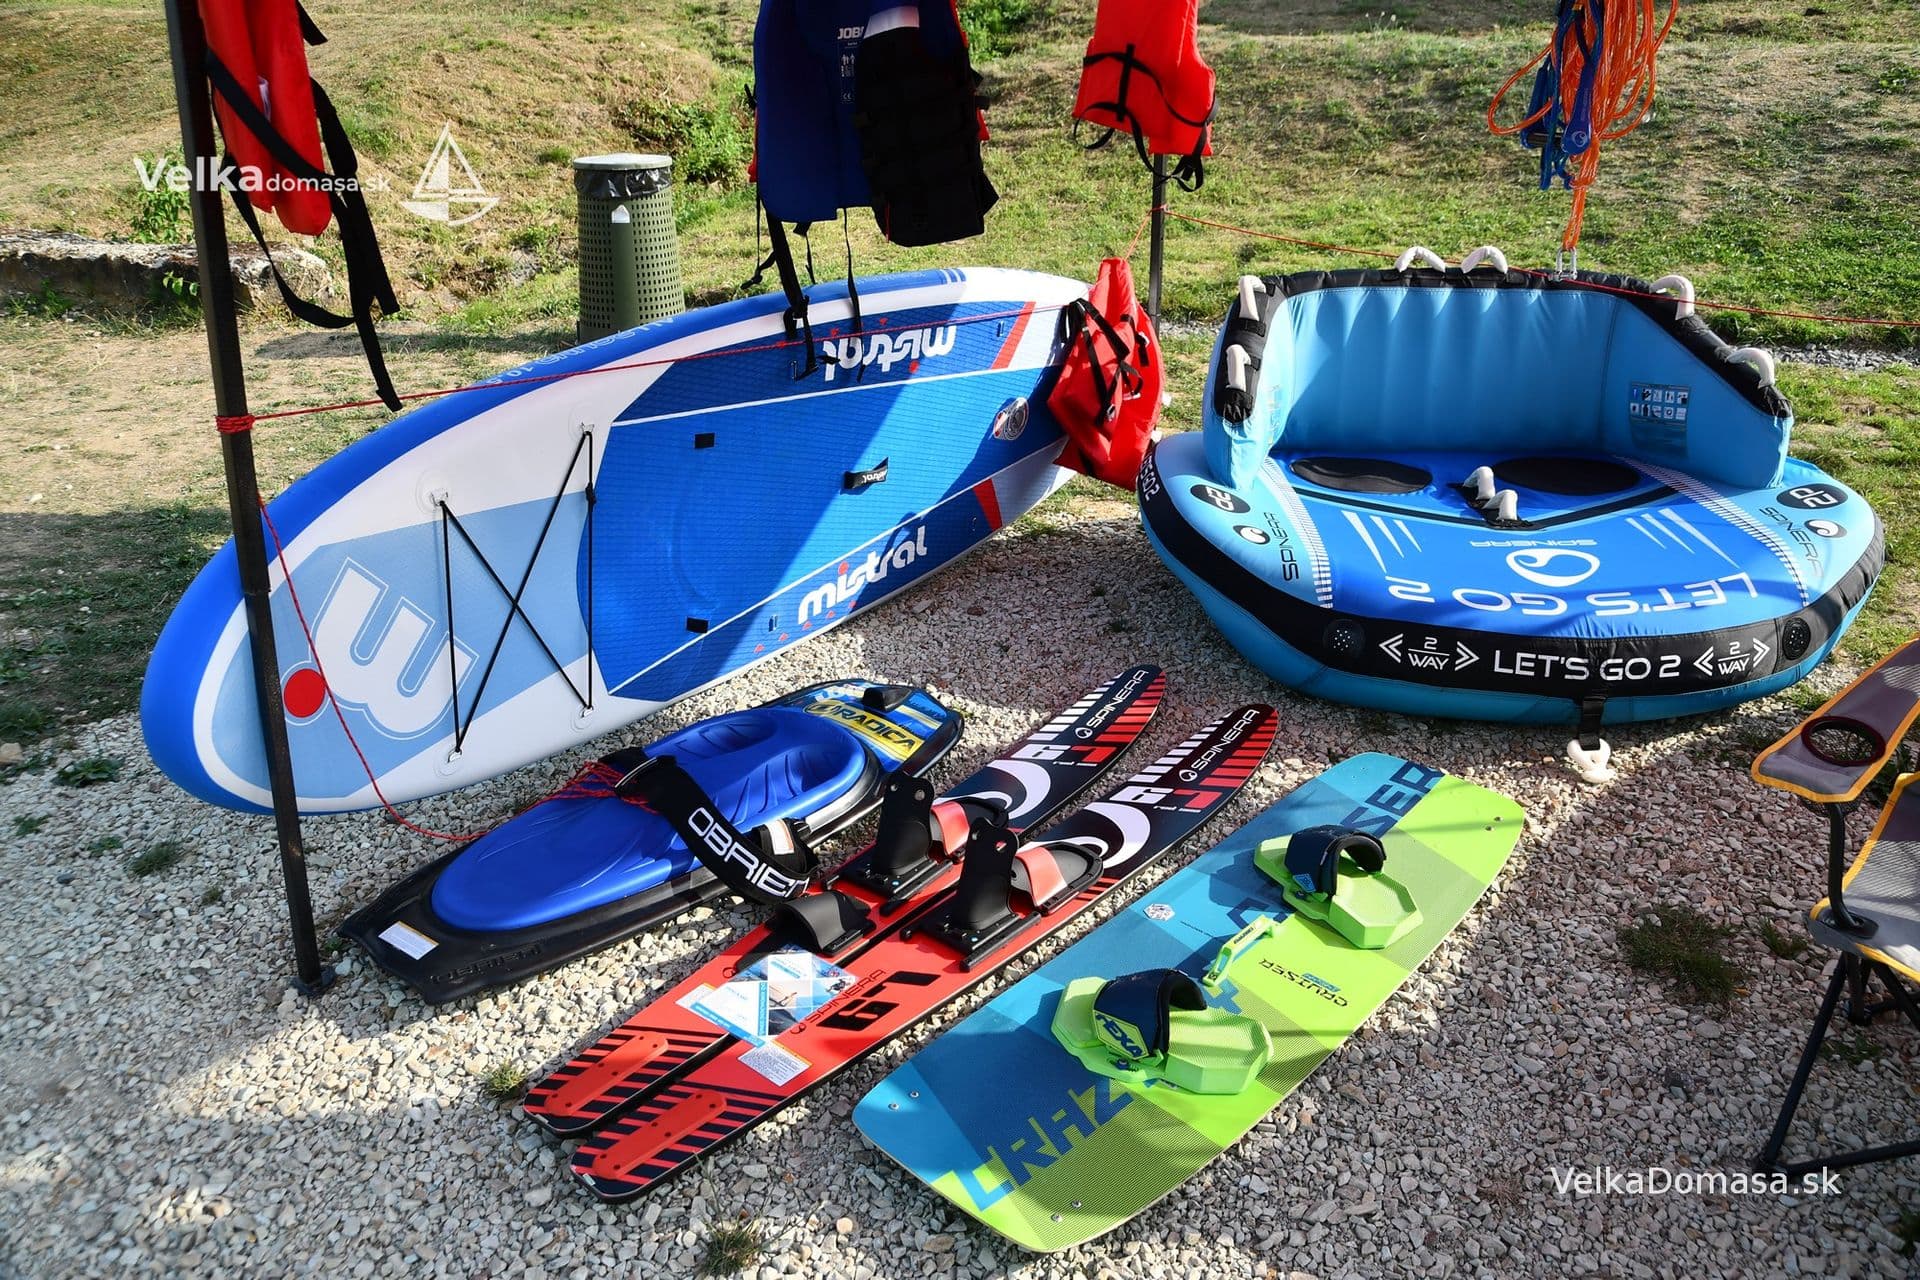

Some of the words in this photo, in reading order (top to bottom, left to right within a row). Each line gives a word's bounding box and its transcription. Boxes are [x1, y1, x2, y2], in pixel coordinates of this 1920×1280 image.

[822, 325, 957, 381] mistral
[1470, 540, 1598, 548] SPINERA
[798, 525, 928, 625] mistral
[1385, 576, 1436, 603] 2
[1586, 572, 1758, 616] LET'S
[1452, 588, 1568, 616] GO
[1407, 653, 1450, 672] WAY
[1423, 636, 1438, 650] 2
[1493, 649, 1590, 681] LET'S
[1599, 655, 1652, 681] GO
[1659, 655, 1681, 678] 2
[1729, 641, 1741, 656] 2
[1717, 656, 1750, 676] WAY
[1086, 669, 1149, 728] SPINERA
[835, 704, 917, 751] RADICA
[1191, 708, 1261, 771] SPINERA
[805, 968, 887, 1024] SPINERA
[1258, 957, 1348, 1007] CRUISER
[952, 1076, 1135, 1213] CRAZ
